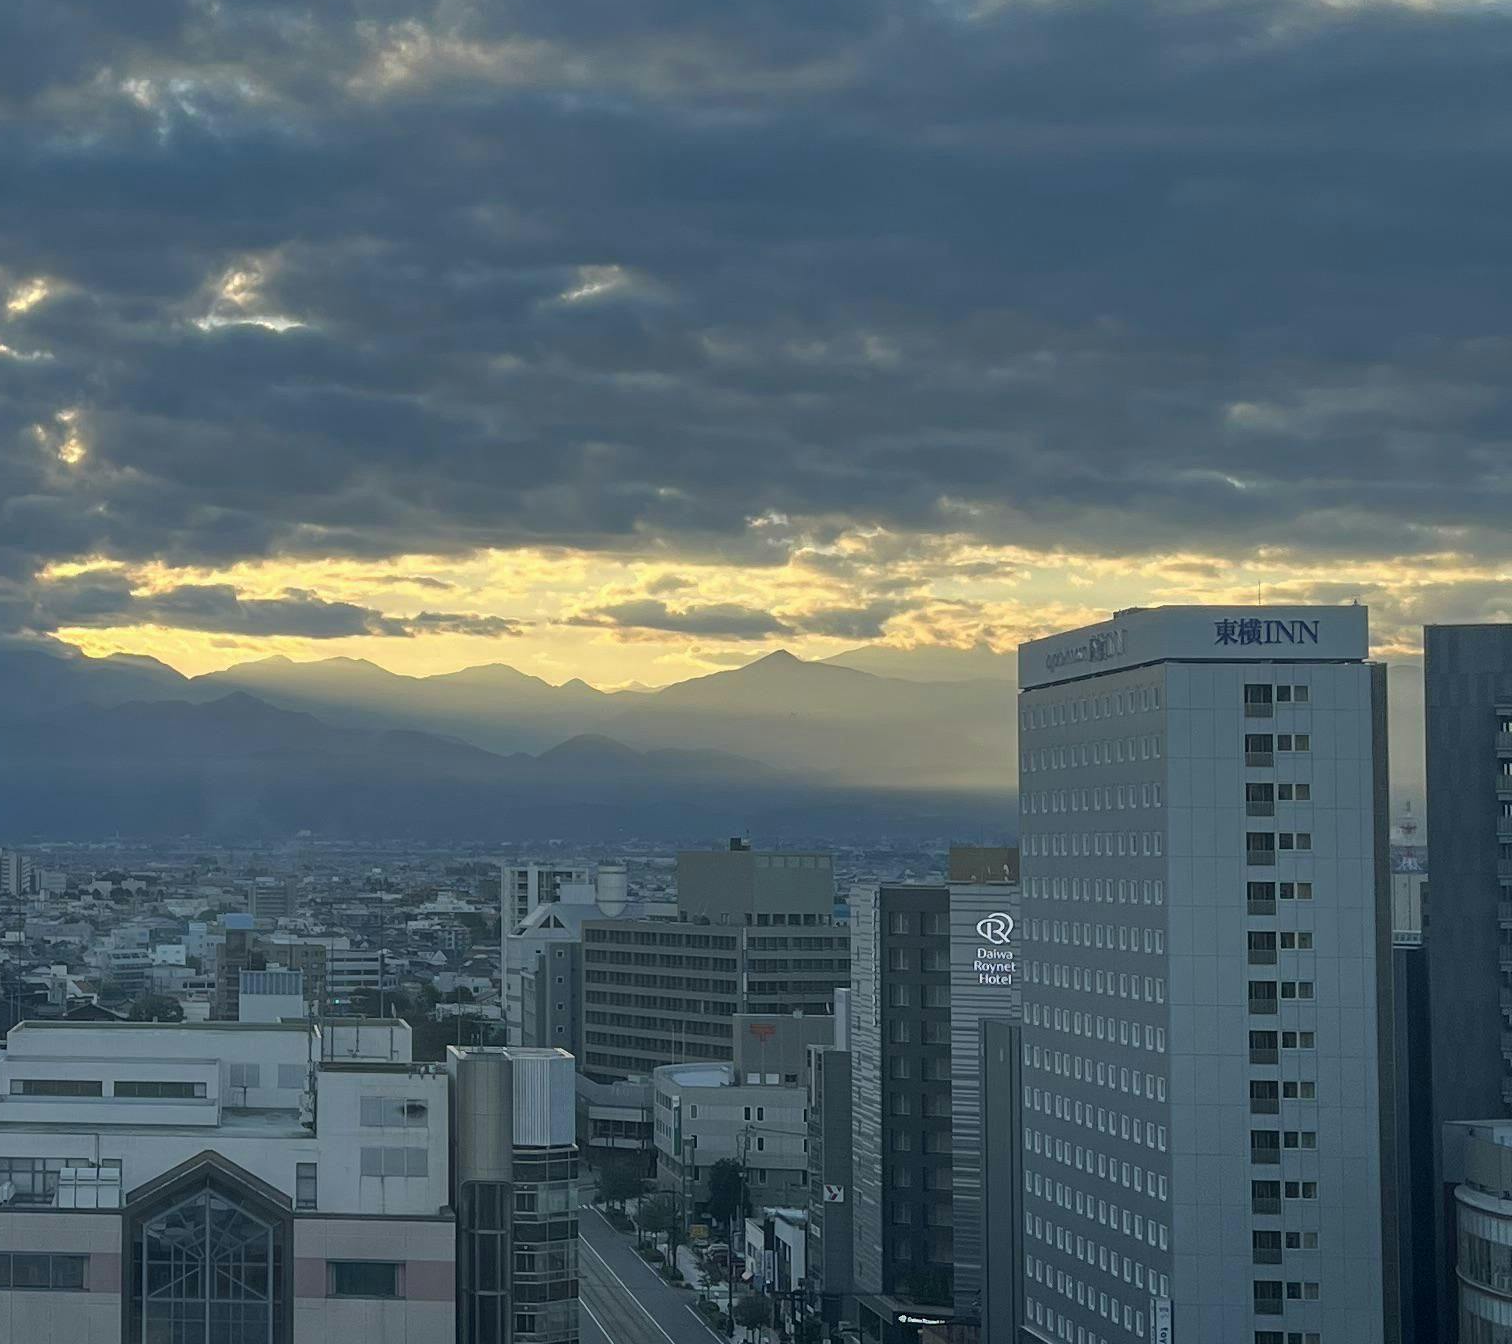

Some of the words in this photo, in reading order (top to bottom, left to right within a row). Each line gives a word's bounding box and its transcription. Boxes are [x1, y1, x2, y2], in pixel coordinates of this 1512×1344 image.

[1214, 618, 1320, 645] 東横INN
[977, 948, 1013, 959] Daiwa
[974, 960, 1017, 973] Roynet
[979, 973, 1012, 985] Hotel
